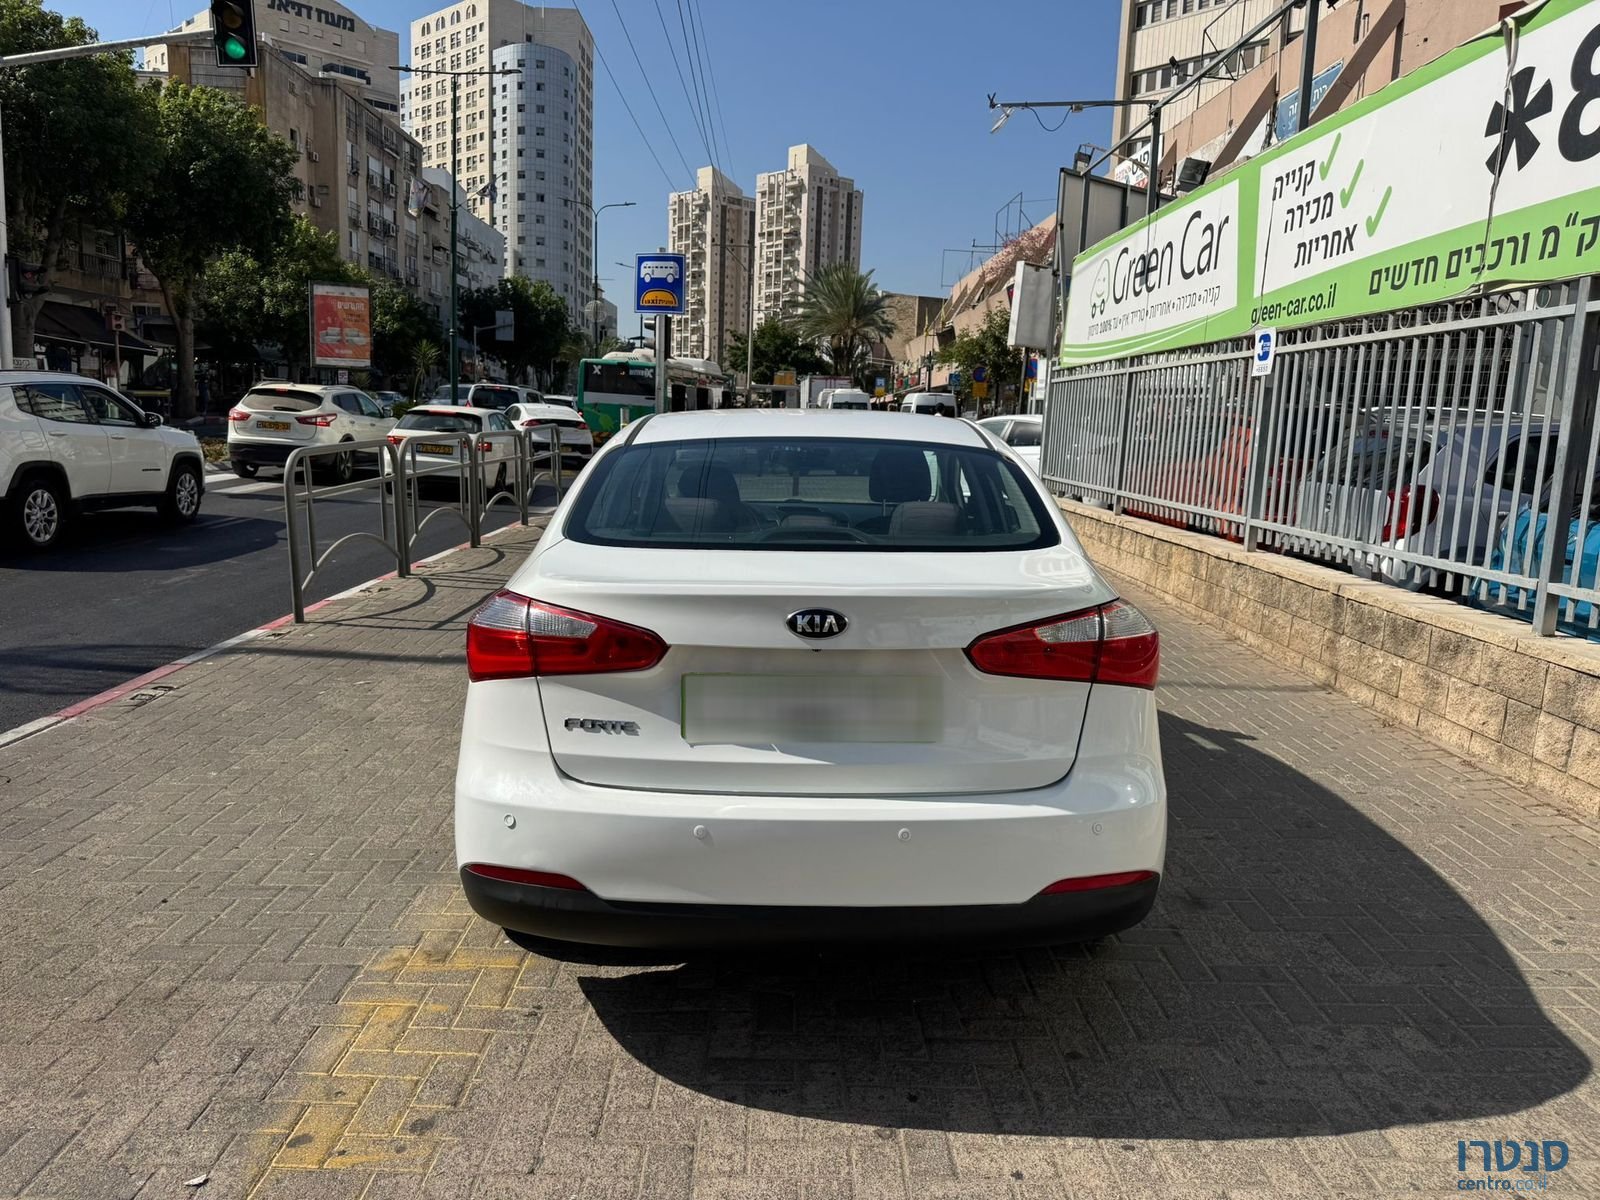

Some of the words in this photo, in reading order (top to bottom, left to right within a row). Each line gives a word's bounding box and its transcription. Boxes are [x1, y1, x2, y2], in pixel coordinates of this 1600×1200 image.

[1272, 160, 1316, 201] קנייה
[1284, 191, 1334, 233] מכירה
[1113, 240, 1173, 304] Green
[1180, 210, 1230, 280] Car
[1294, 223, 1358, 268] אחריות
[1445, 231, 1531, 280] ורכבים
[1202, 285, 1221, 307] קניה
[1369, 255, 1439, 296] חדשים
[1175, 292, 1197, 312] מכירה
[795, 613, 840, 633] KIA
[564, 717, 641, 737] FORTE
